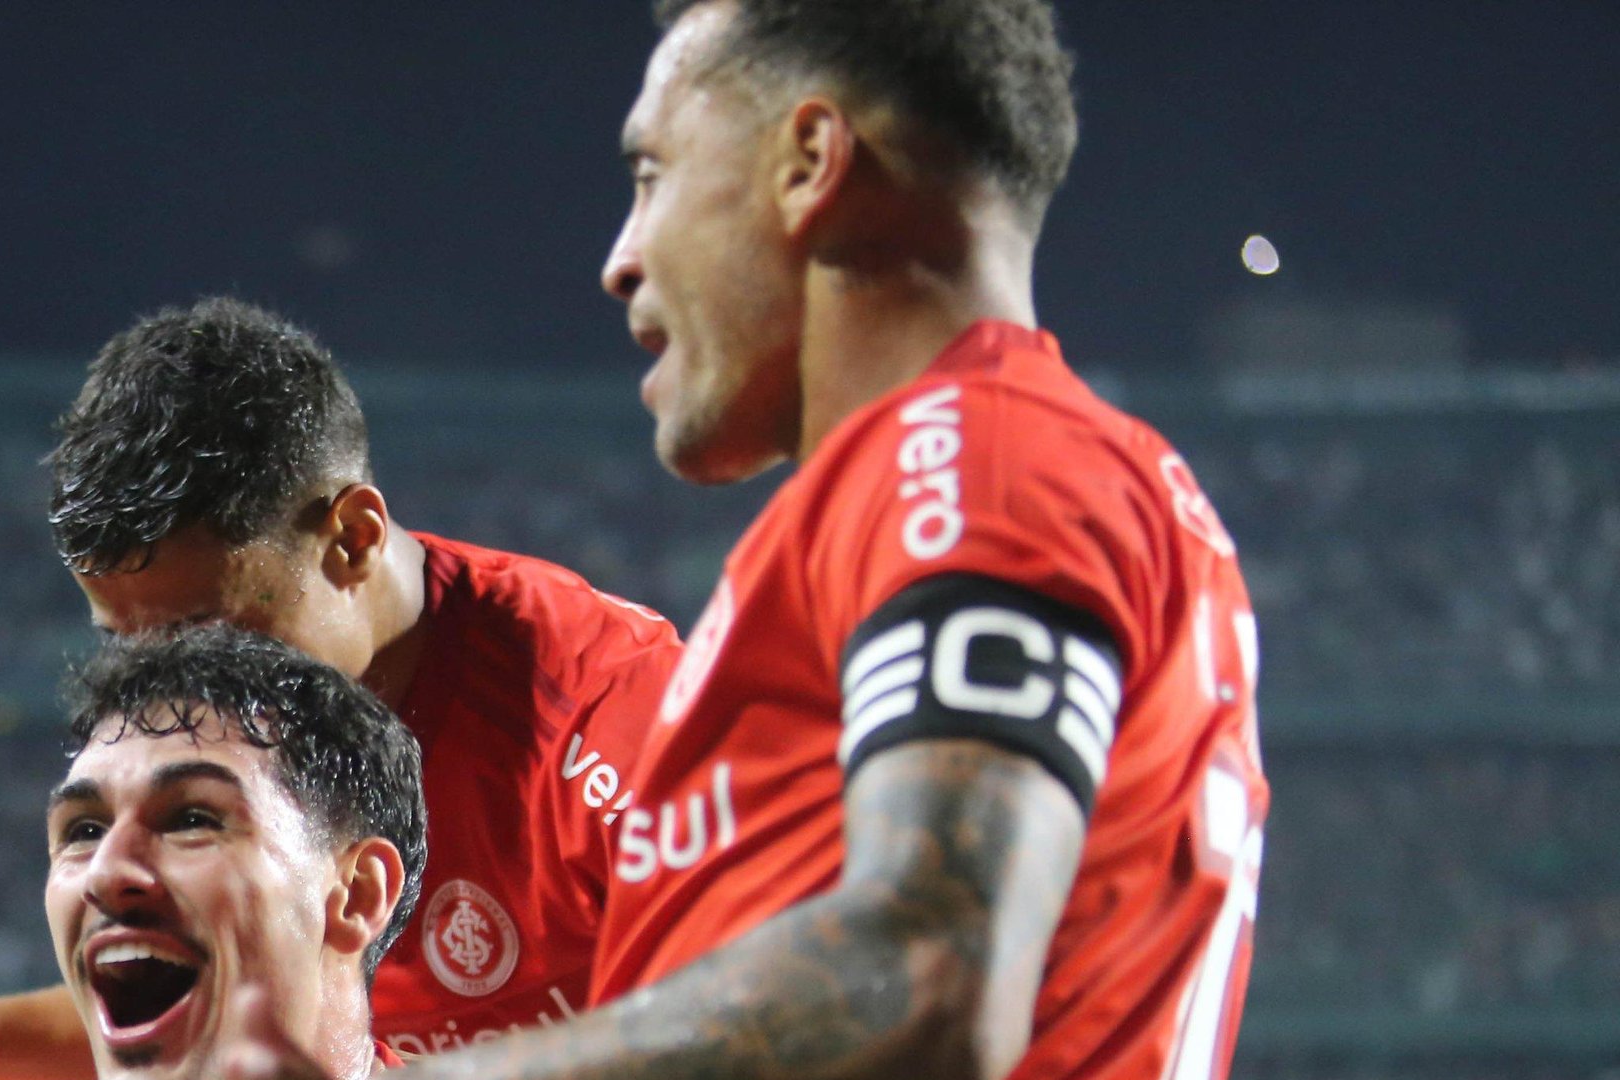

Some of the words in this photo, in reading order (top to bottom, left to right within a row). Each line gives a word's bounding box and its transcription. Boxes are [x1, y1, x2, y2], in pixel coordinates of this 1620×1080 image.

[898, 384, 964, 560] vero
[931, 606, 1055, 720] C
[561, 732, 634, 827] ve
[616, 761, 736, 883] sul
